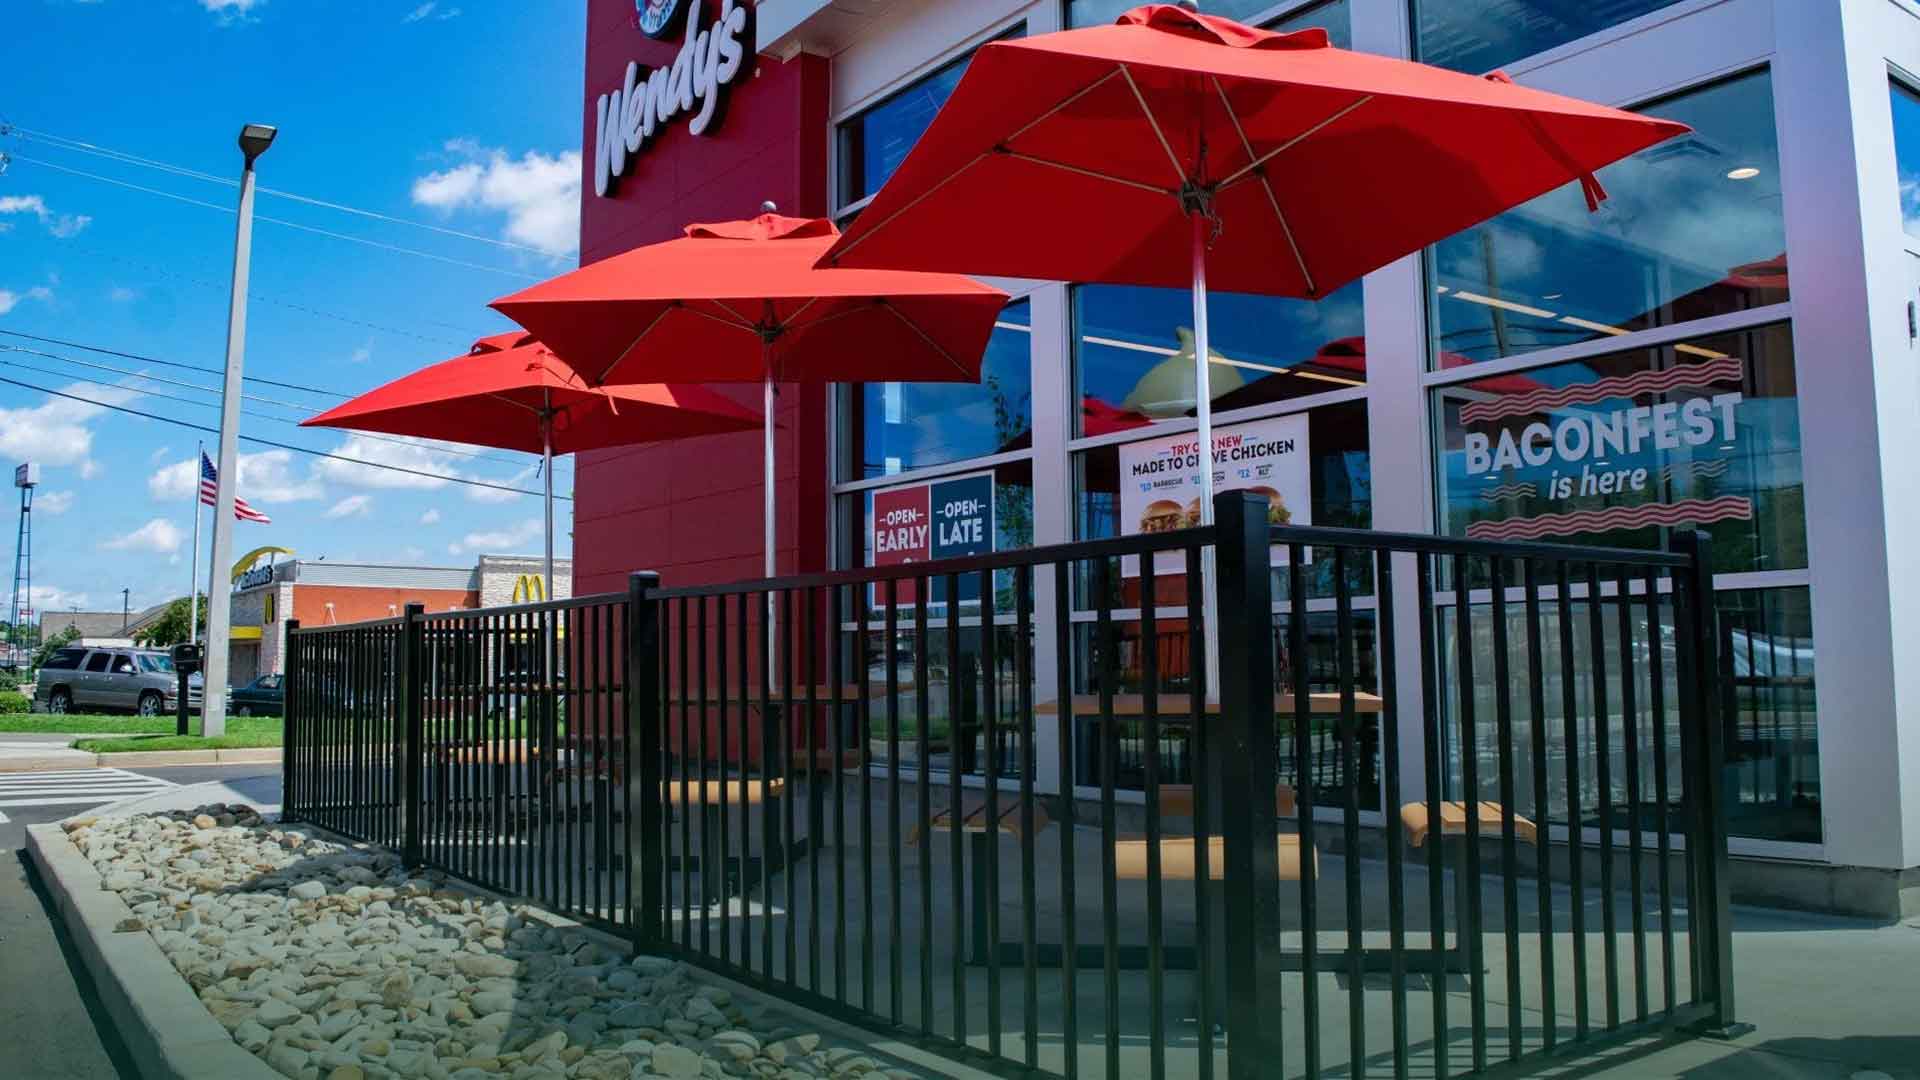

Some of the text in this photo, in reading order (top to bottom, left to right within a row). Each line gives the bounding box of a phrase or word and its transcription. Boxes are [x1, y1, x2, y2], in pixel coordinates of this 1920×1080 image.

[595, 0, 746, 196] Wendy's
[1171, 443, 1191, 456] TRY
[1218, 435, 1242, 449] NEW
[1465, 392, 1742, 474] BACONFEST
[1132, 439, 1295, 476] MADE TO CVE CHICKEN
[1550, 465, 1648, 500] is here
[886, 508, 916, 526] OPEN
[944, 499, 978, 518] OPEN
[876, 525, 928, 553] EARLY
[939, 518, 983, 546] LATE
